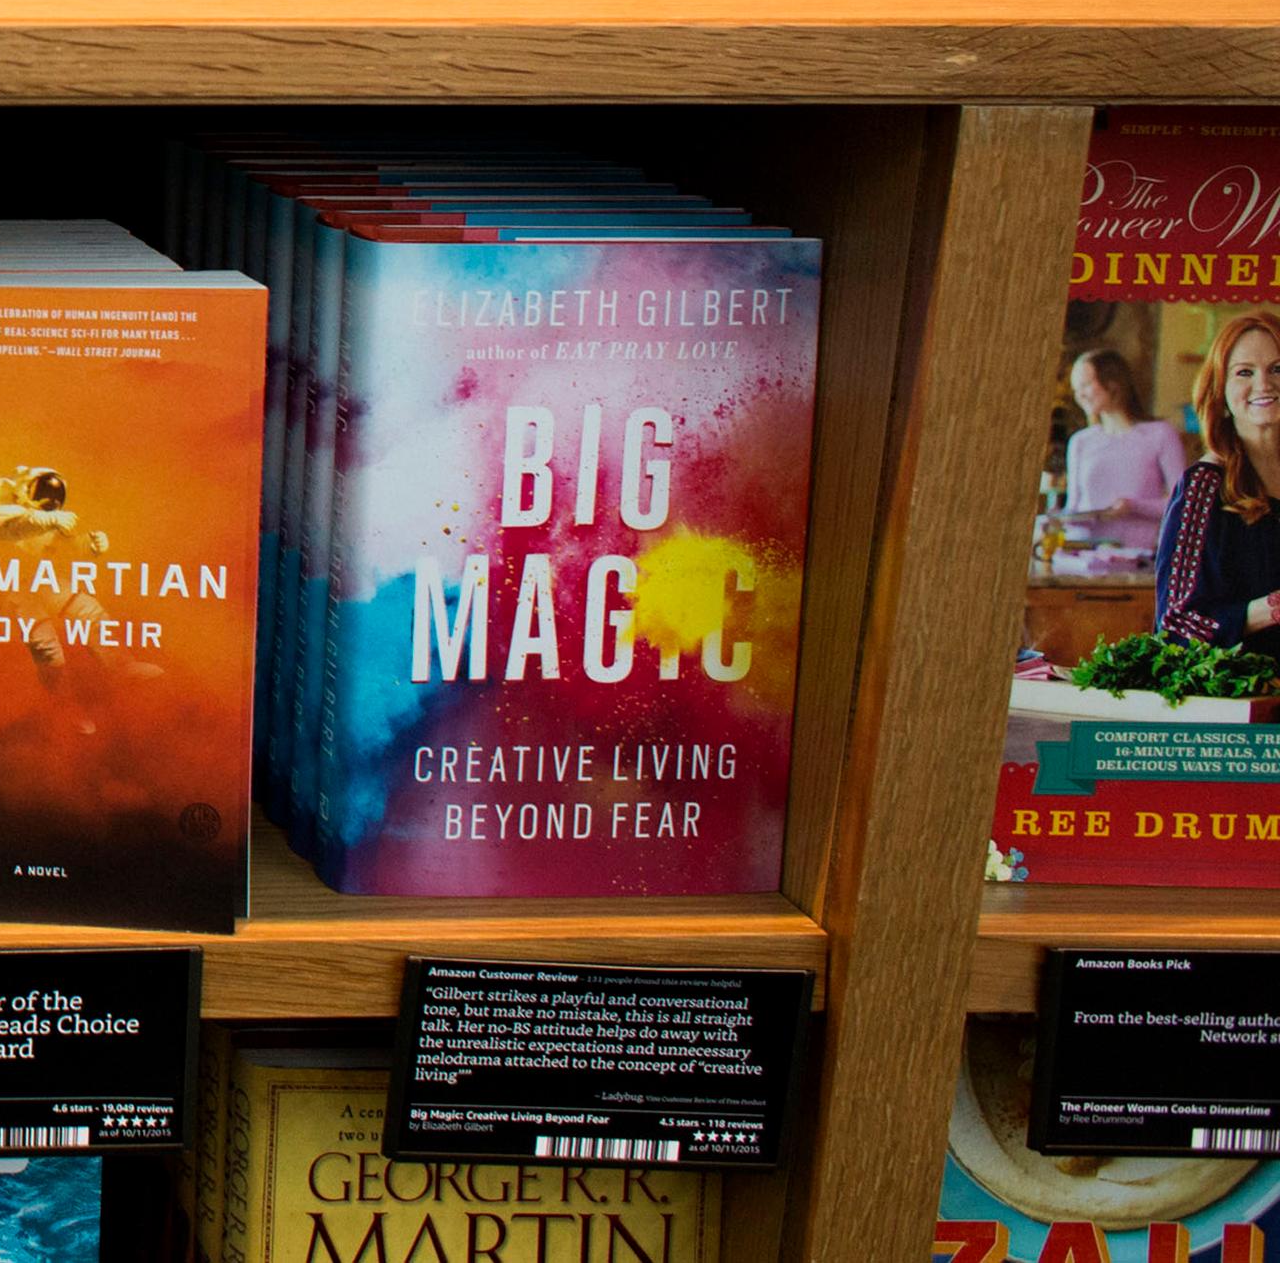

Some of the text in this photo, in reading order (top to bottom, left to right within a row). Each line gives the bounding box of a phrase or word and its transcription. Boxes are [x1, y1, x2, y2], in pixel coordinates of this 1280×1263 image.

[413, 288, 793, 327] ELIZABETH GILBERT
[465, 341, 738, 360] author of EAT PRAY LOVE
[501, 404, 673, 531] BIG
[411, 553, 755, 683] MAGC
[65, 618, 162, 648] WEIR
[1095, 732, 1169, 743] COMFORT
[414, 744, 735, 782] CREATIVE LIVING
[1096, 760, 1246, 772] DELICIOUS WAYS TO
[444, 802, 699, 840] BEYOND FEAR
[1012, 810, 1110, 836] REE
[13, 865, 67, 877] A NOVEL
[1076, 958, 1190, 969] Amazon Books Pick
[11, 990, 39, 1011] of
[42, 990, 82, 1010] the
[57, 1014, 139, 1034] Choice
[410, 1109, 609, 1124] Big Magic: Creative Living Beyond Fear
[1061, 1102, 1270, 1115] The Pioneer Woman Cooks: Dinnertime
[308, 1152, 542, 1204] GEORGE
